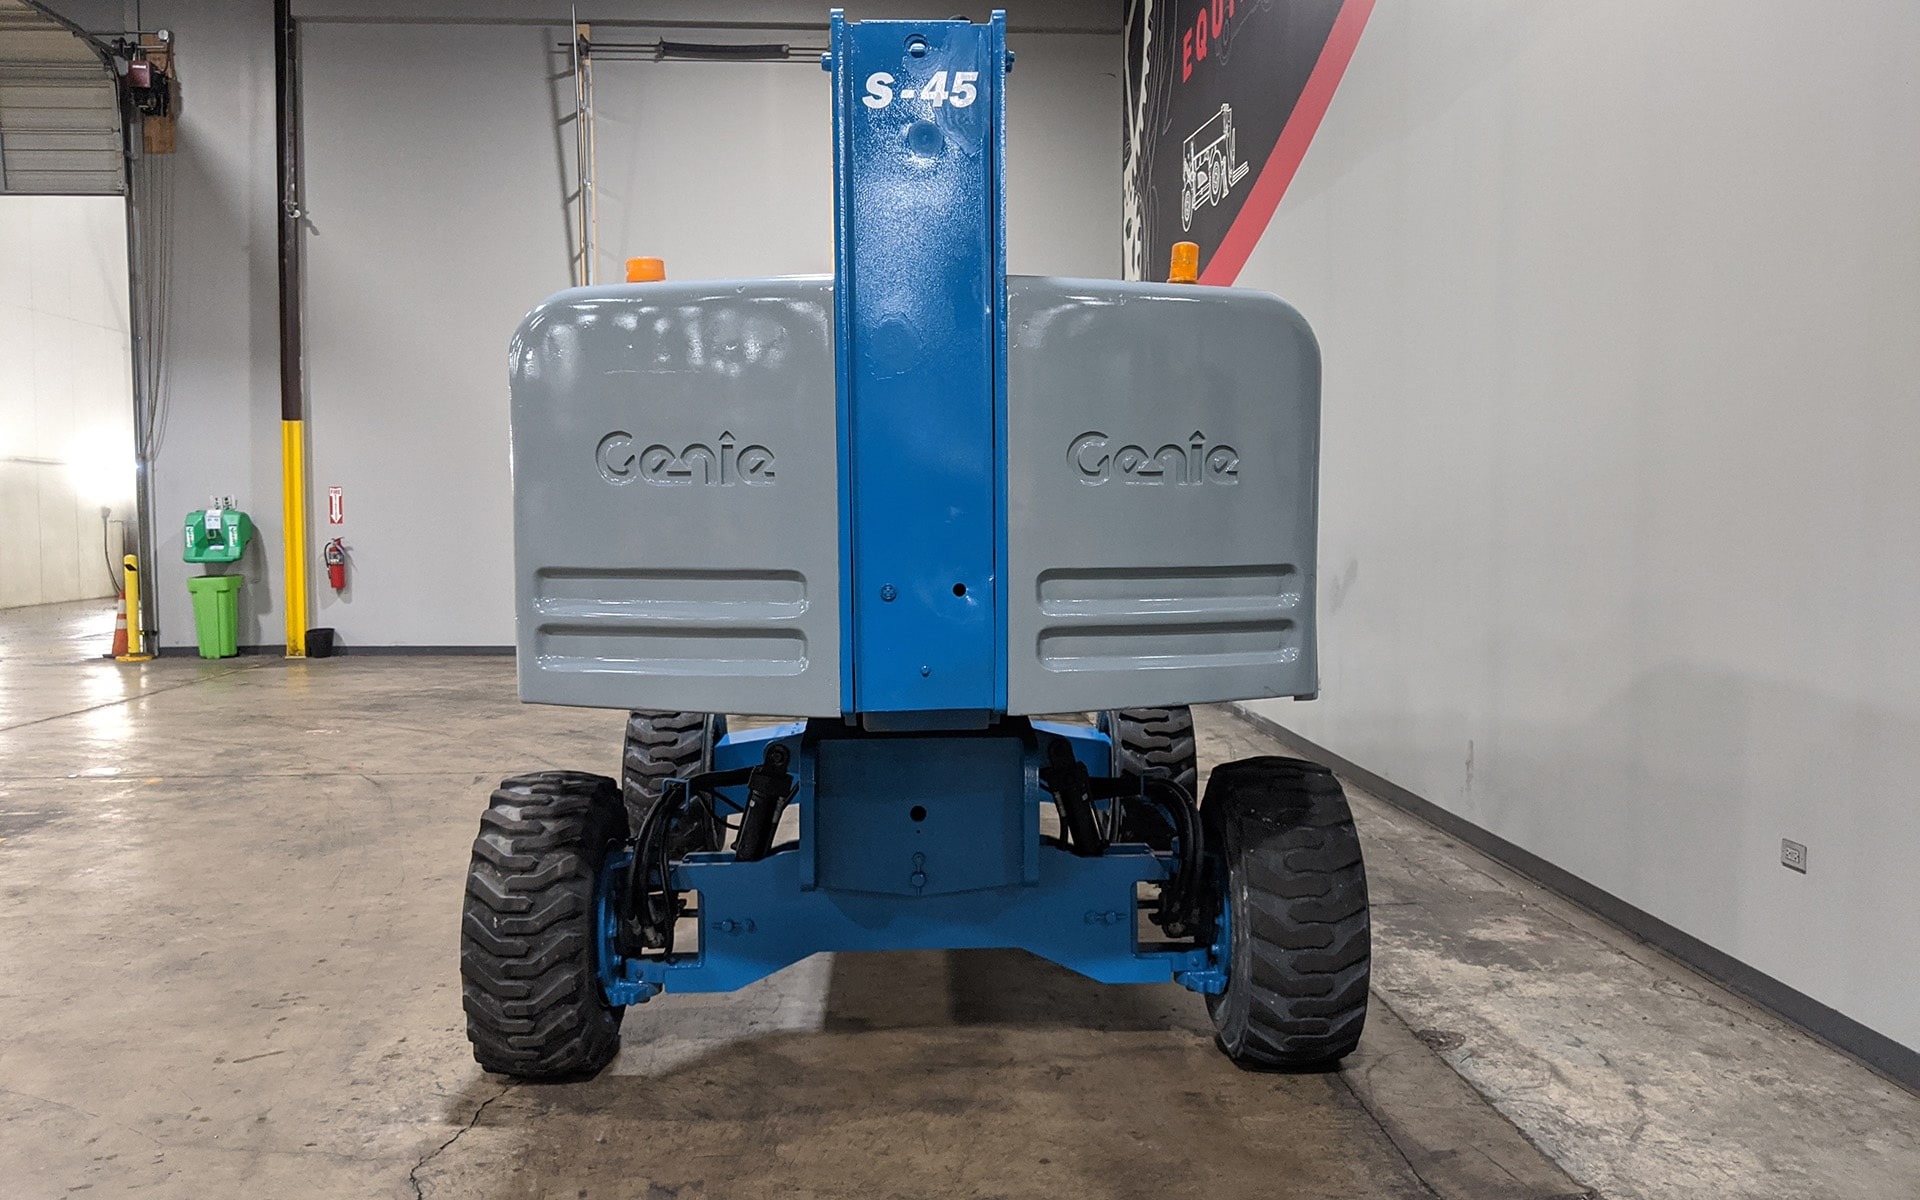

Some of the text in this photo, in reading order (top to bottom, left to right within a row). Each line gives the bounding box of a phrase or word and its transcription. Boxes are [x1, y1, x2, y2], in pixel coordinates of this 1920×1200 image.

[862, 71, 979, 109] S-45
[595, 430, 776, 486] Genie
[1066, 430, 1240, 486] Genie
